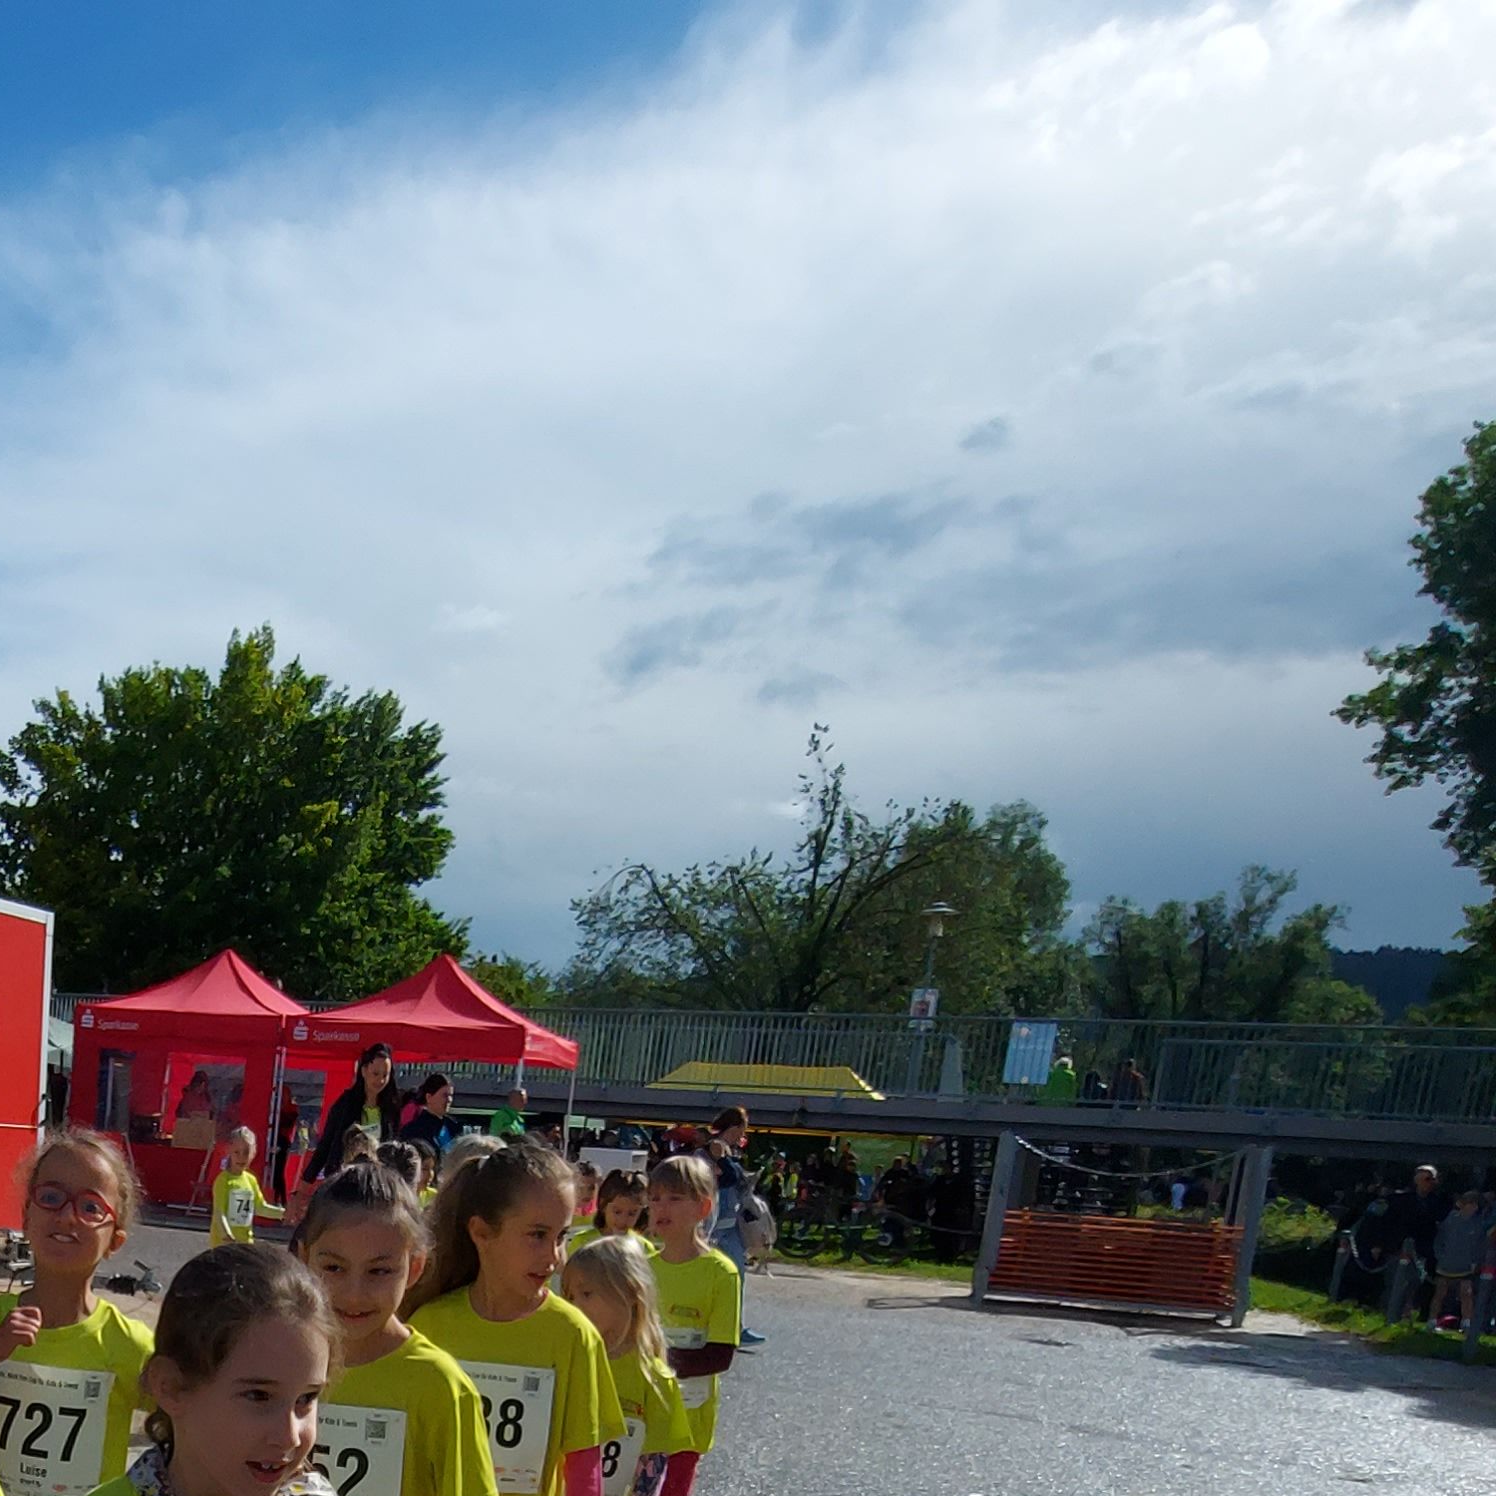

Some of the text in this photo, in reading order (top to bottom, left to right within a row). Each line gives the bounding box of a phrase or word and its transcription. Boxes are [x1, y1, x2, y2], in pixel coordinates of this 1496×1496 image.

[97, 1019, 139, 1031] Sparkasse
[312, 1030, 359, 1043] Sparkasse
[602, 1440, 622, 1478] 8
[20, 1462, 47, 1478] Luise
